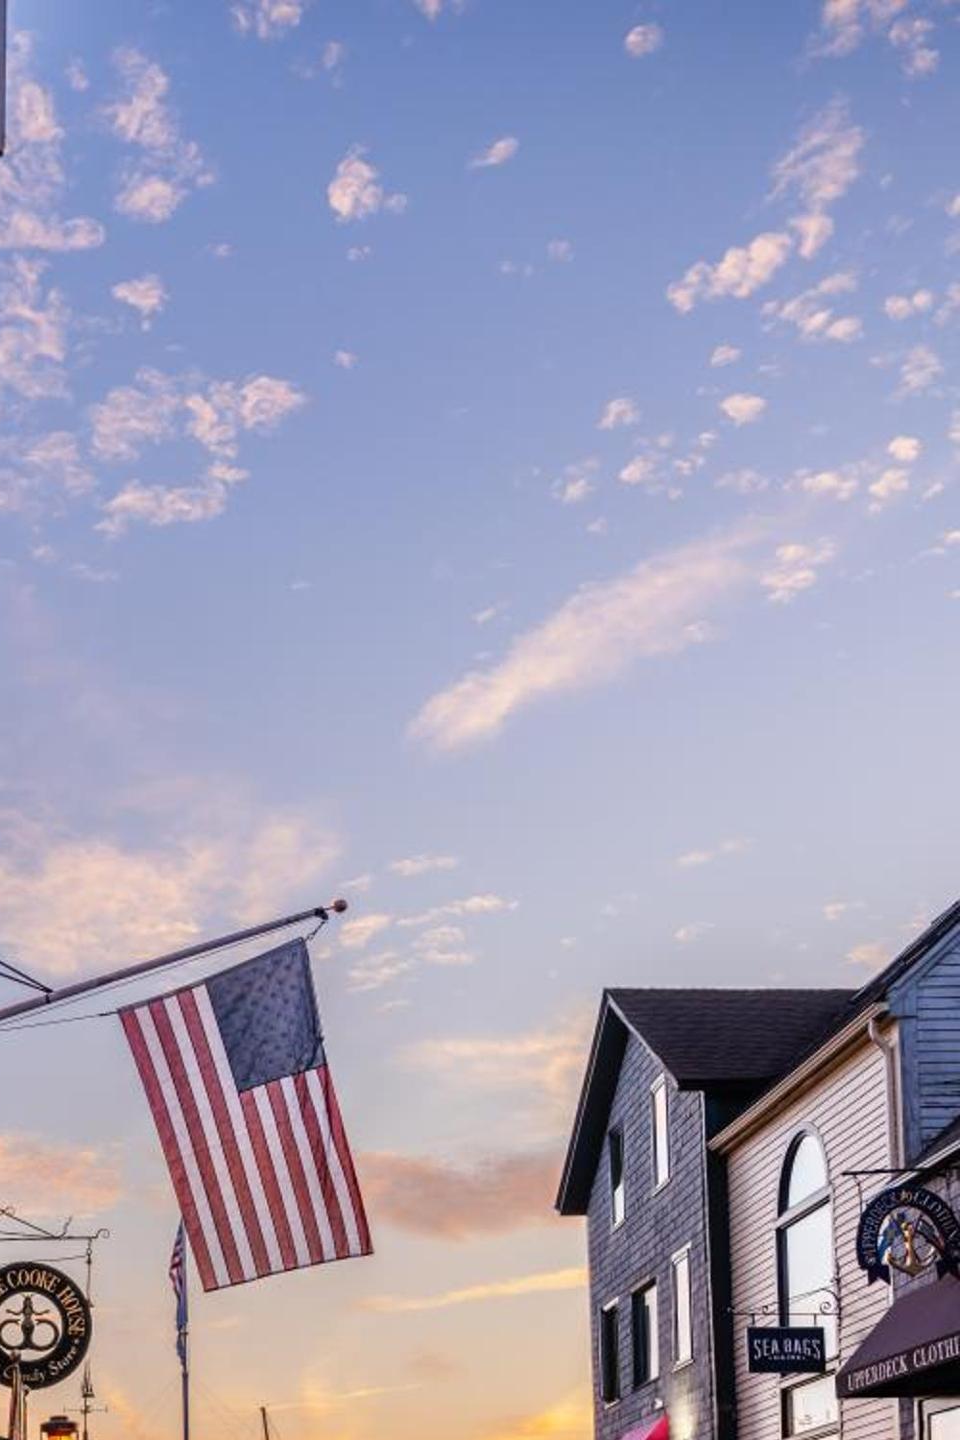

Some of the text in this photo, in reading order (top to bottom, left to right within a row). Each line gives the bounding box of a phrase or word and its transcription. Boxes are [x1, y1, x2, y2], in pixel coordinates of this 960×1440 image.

[7, 1268, 60, 1293] COOKE
[58, 1286, 86, 1337] HOUSE
[2, 1363, 46, 1382] Cndy
[47, 1346, 77, 1376] Store
[753, 1337, 821, 1360] SEA BAGS
[847, 1353, 908, 1391] UPPERDECK
